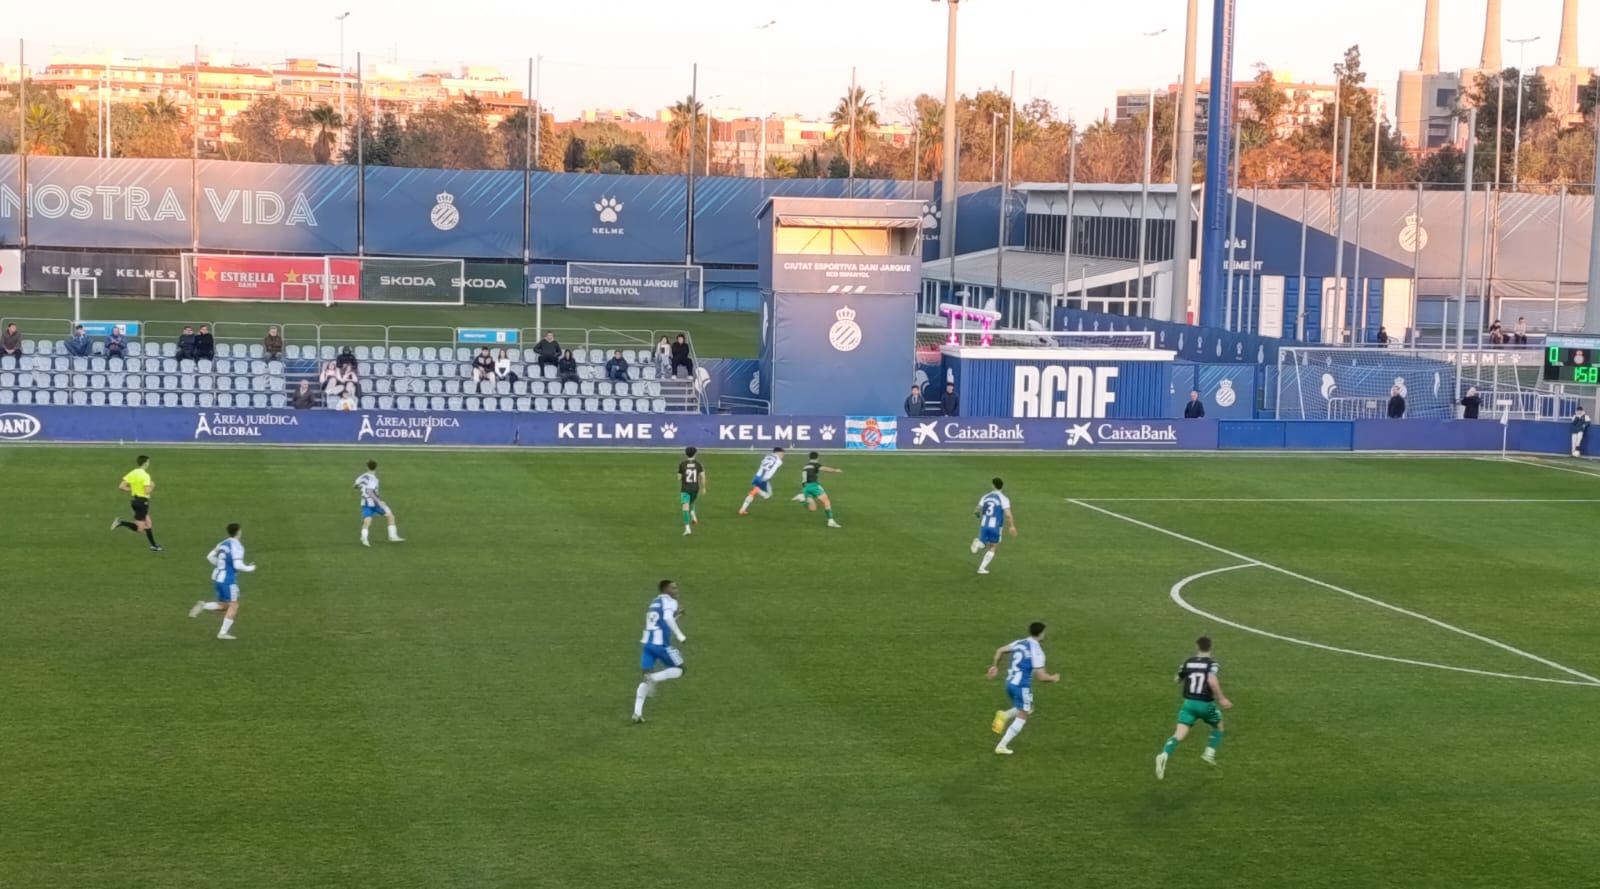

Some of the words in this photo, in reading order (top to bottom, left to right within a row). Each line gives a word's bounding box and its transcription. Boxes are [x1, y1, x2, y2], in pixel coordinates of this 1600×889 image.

[1, 183, 187, 221] NOSTRA
[204, 188, 319, 226] VIDA
[592, 227, 625, 235] KELME
[41, 265, 91, 276] KELME
[116, 268, 166, 278] KELME
[784, 262, 813, 271] CIUTAT
[814, 262, 858, 272] ESPORTIVA
[859, 263, 879, 272] DANI
[880, 263, 912, 273] JARQUE
[220, 271, 275, 283] ESTRELLA
[380, 276, 436, 287] SKODA
[534, 276, 566, 285] CIUTAT
[567, 277, 619, 287] ESPORTIVA
[620, 278, 642, 287] DANI
[643, 279, 679, 288] JARQUE
[573, 286, 592, 294] RCD
[593, 286, 640, 296] ESPANYOL
[1447, 353, 1505, 364] KELME
[245, 413, 299, 426] JURÍDICA
[212, 426, 262, 436] GLOBAL
[375, 428, 424, 438] GLOBAL
[558, 422, 653, 439] KELME
[719, 424, 811, 441] KELME
[944, 422, 1025, 440] CaixaBank
[1097, 423, 1178, 441] CaixaBank
[686, 468, 698, 483] 21
[985, 501, 995, 517] 3
[1012, 651, 1023, 672] 2
[1188, 672, 1206, 695] 17
